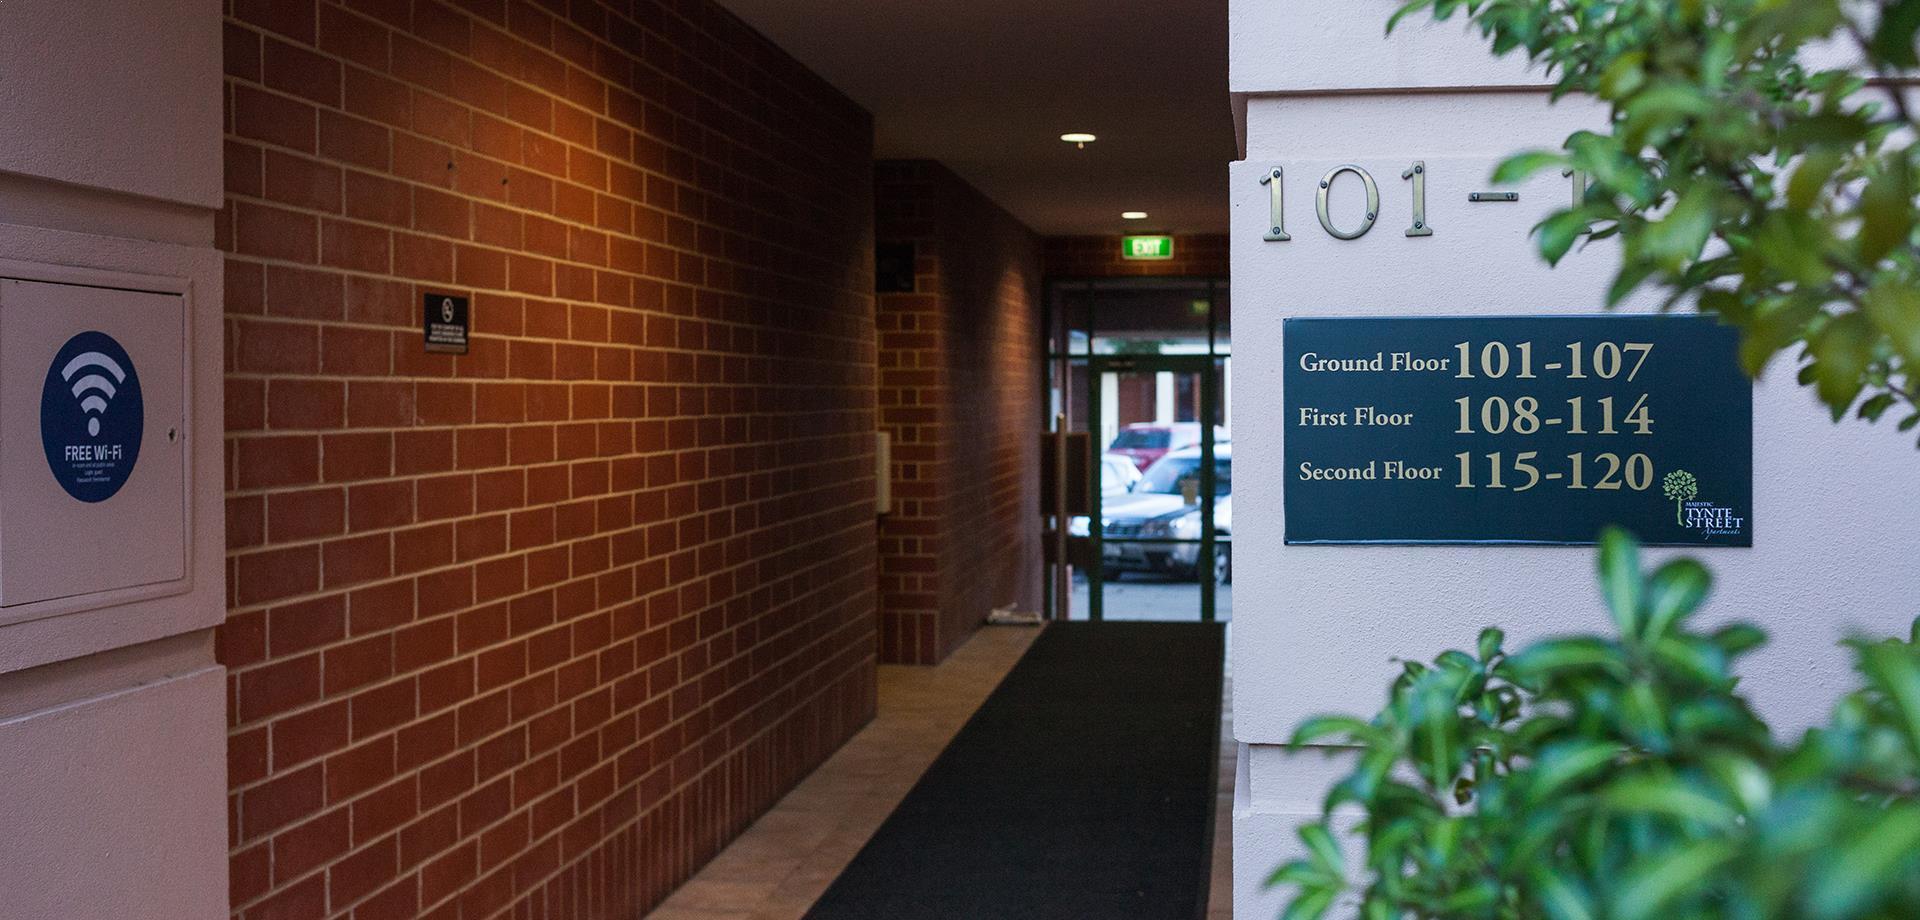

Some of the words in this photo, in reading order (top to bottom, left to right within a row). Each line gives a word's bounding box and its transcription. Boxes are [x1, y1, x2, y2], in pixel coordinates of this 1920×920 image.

[1299, 352, 1384, 372] Ground
[1390, 352, 1450, 372] Floor
[1454, 341, 1654, 382] 101-107
[1299, 407, 1347, 427] First
[1354, 406, 1413, 426] Floor
[1454, 393, 1654, 435] 108-114
[65, 445, 92, 461] FREE
[93, 444, 122, 460] Wi-Fi
[1299, 461, 1376, 481] Second
[1383, 460, 1443, 480] Floor
[1454, 451, 1654, 492] 115-120
[1685, 508, 1732, 518] TYNTE
[1685, 517, 1744, 528] STREET
[1701, 528, 1740, 540] Apartments
